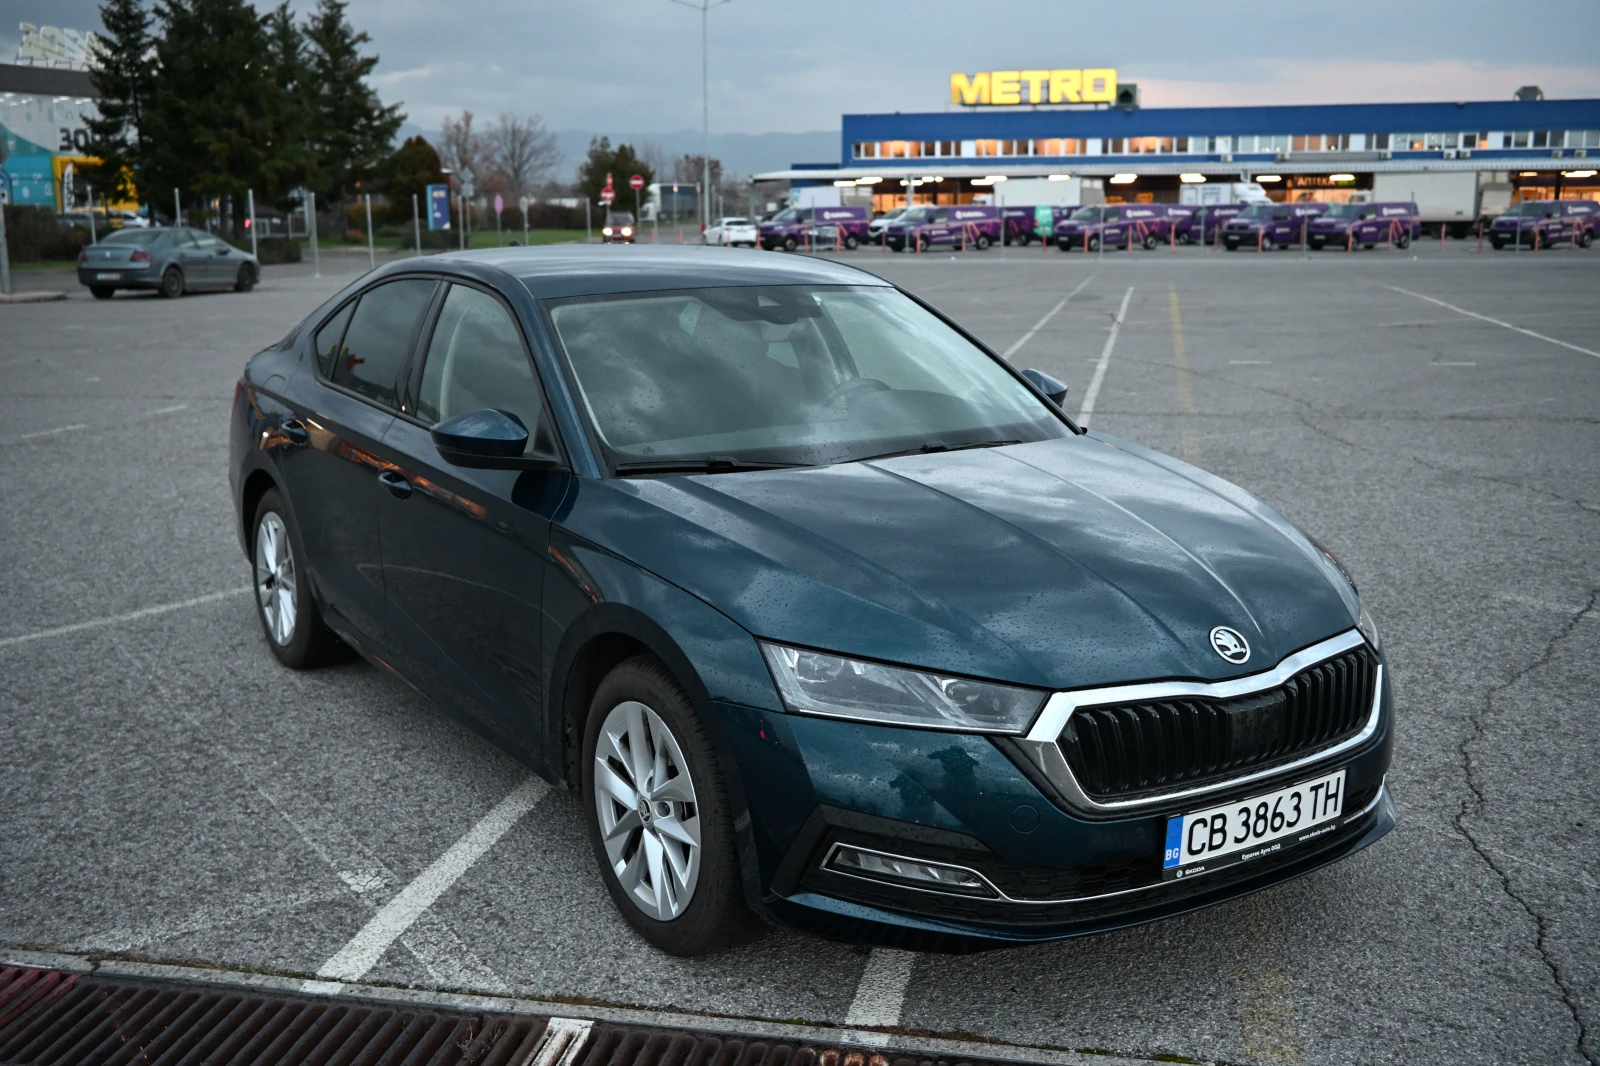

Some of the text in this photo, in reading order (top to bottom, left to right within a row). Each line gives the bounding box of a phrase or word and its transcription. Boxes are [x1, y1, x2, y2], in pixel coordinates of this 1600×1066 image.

[950, 68, 1117, 105] METRO
[1187, 776, 1341, 856] CB 3863 TH
[1165, 848, 1180, 861] BG
